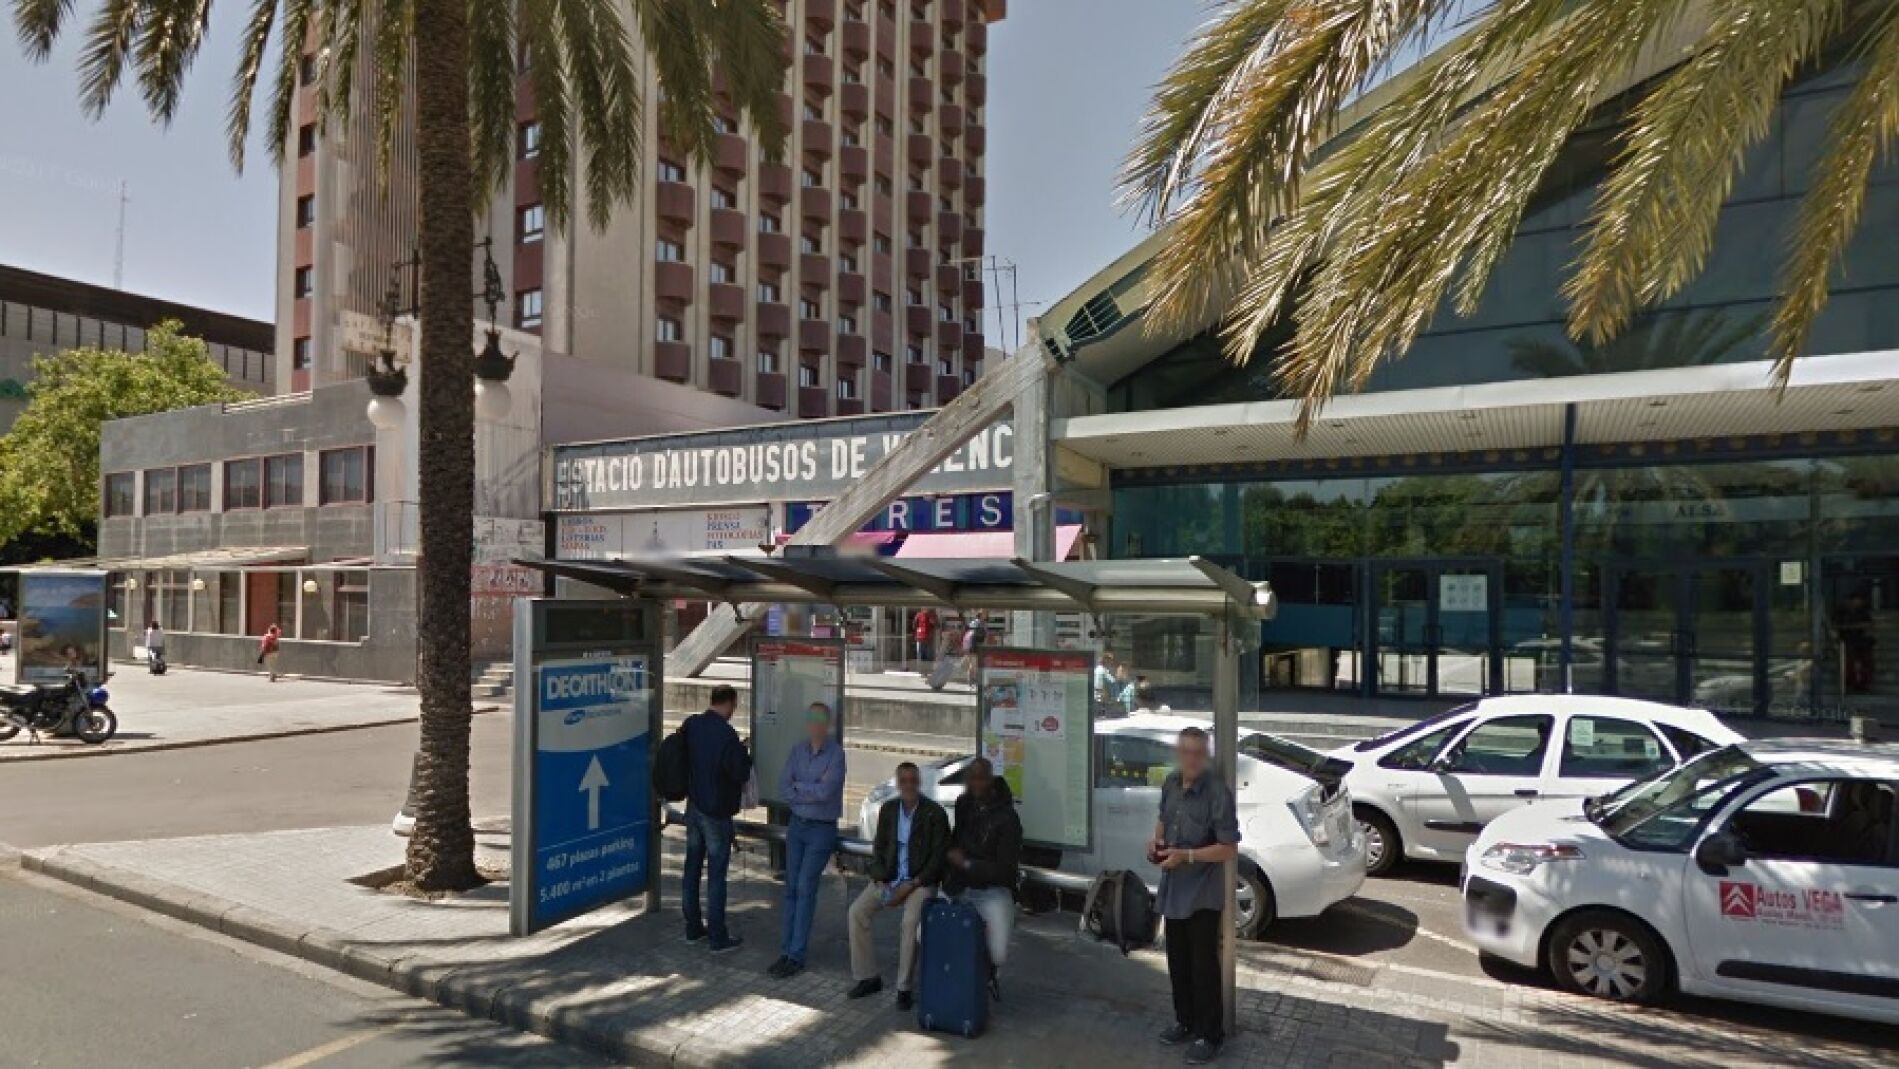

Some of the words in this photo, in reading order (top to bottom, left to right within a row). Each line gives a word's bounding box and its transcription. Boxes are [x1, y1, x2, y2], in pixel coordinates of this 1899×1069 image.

[653, 438, 816, 488] D'AUTOBUSOS
[831, 436, 867, 479] DE
[1756, 886, 1797, 909] Autos
[1802, 888, 1844, 913] VEGA
